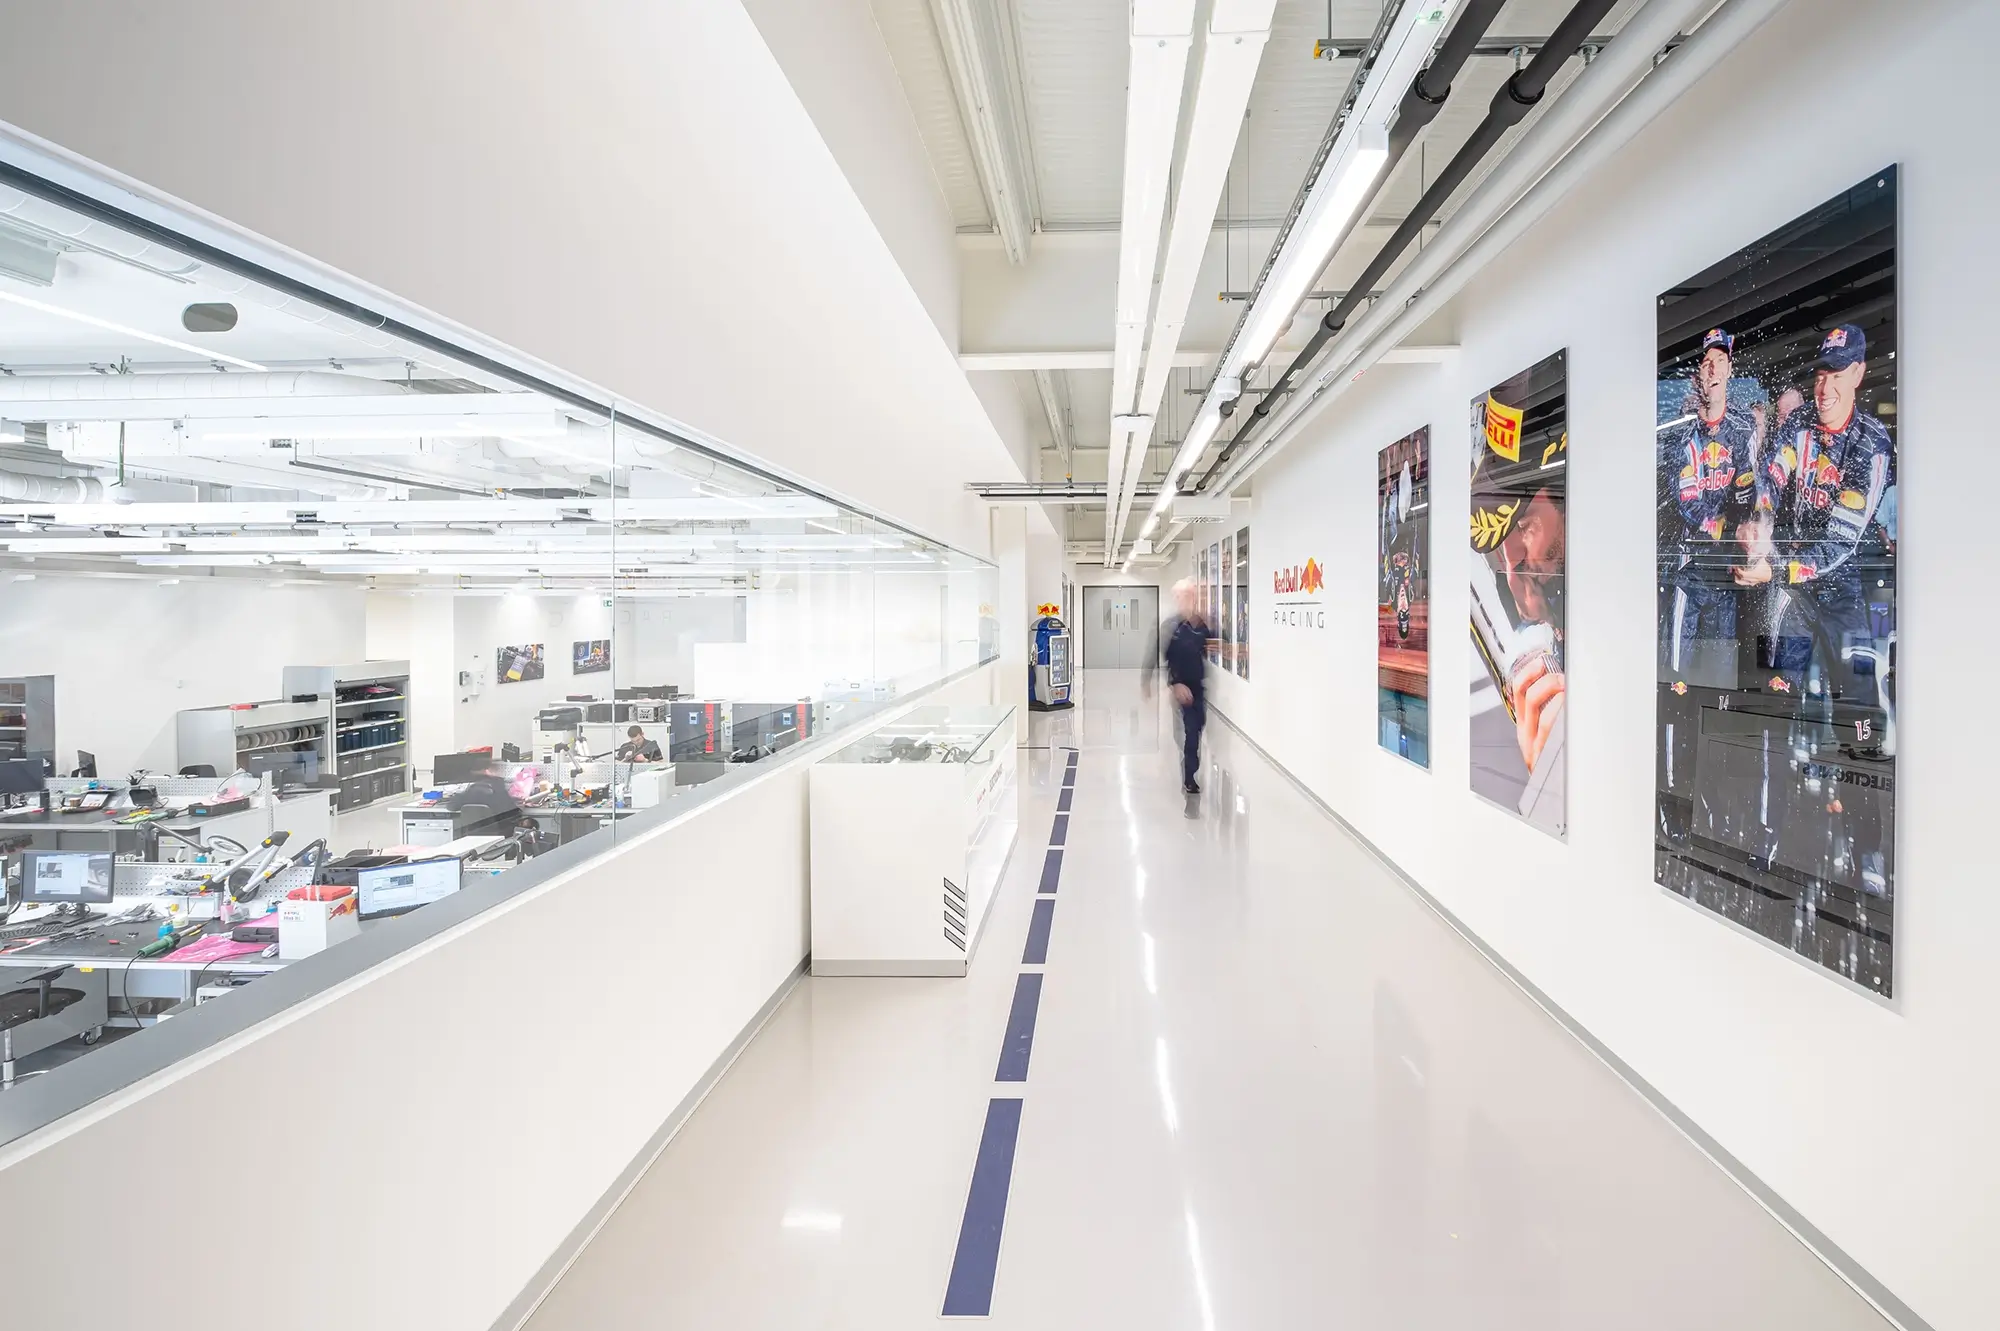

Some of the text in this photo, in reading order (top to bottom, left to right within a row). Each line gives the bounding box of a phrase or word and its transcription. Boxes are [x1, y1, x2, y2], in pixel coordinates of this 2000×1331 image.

[1273, 610, 1324, 629] RACING
[1718, 694, 1729, 711] 14
[1854, 719, 1872, 741] 15
